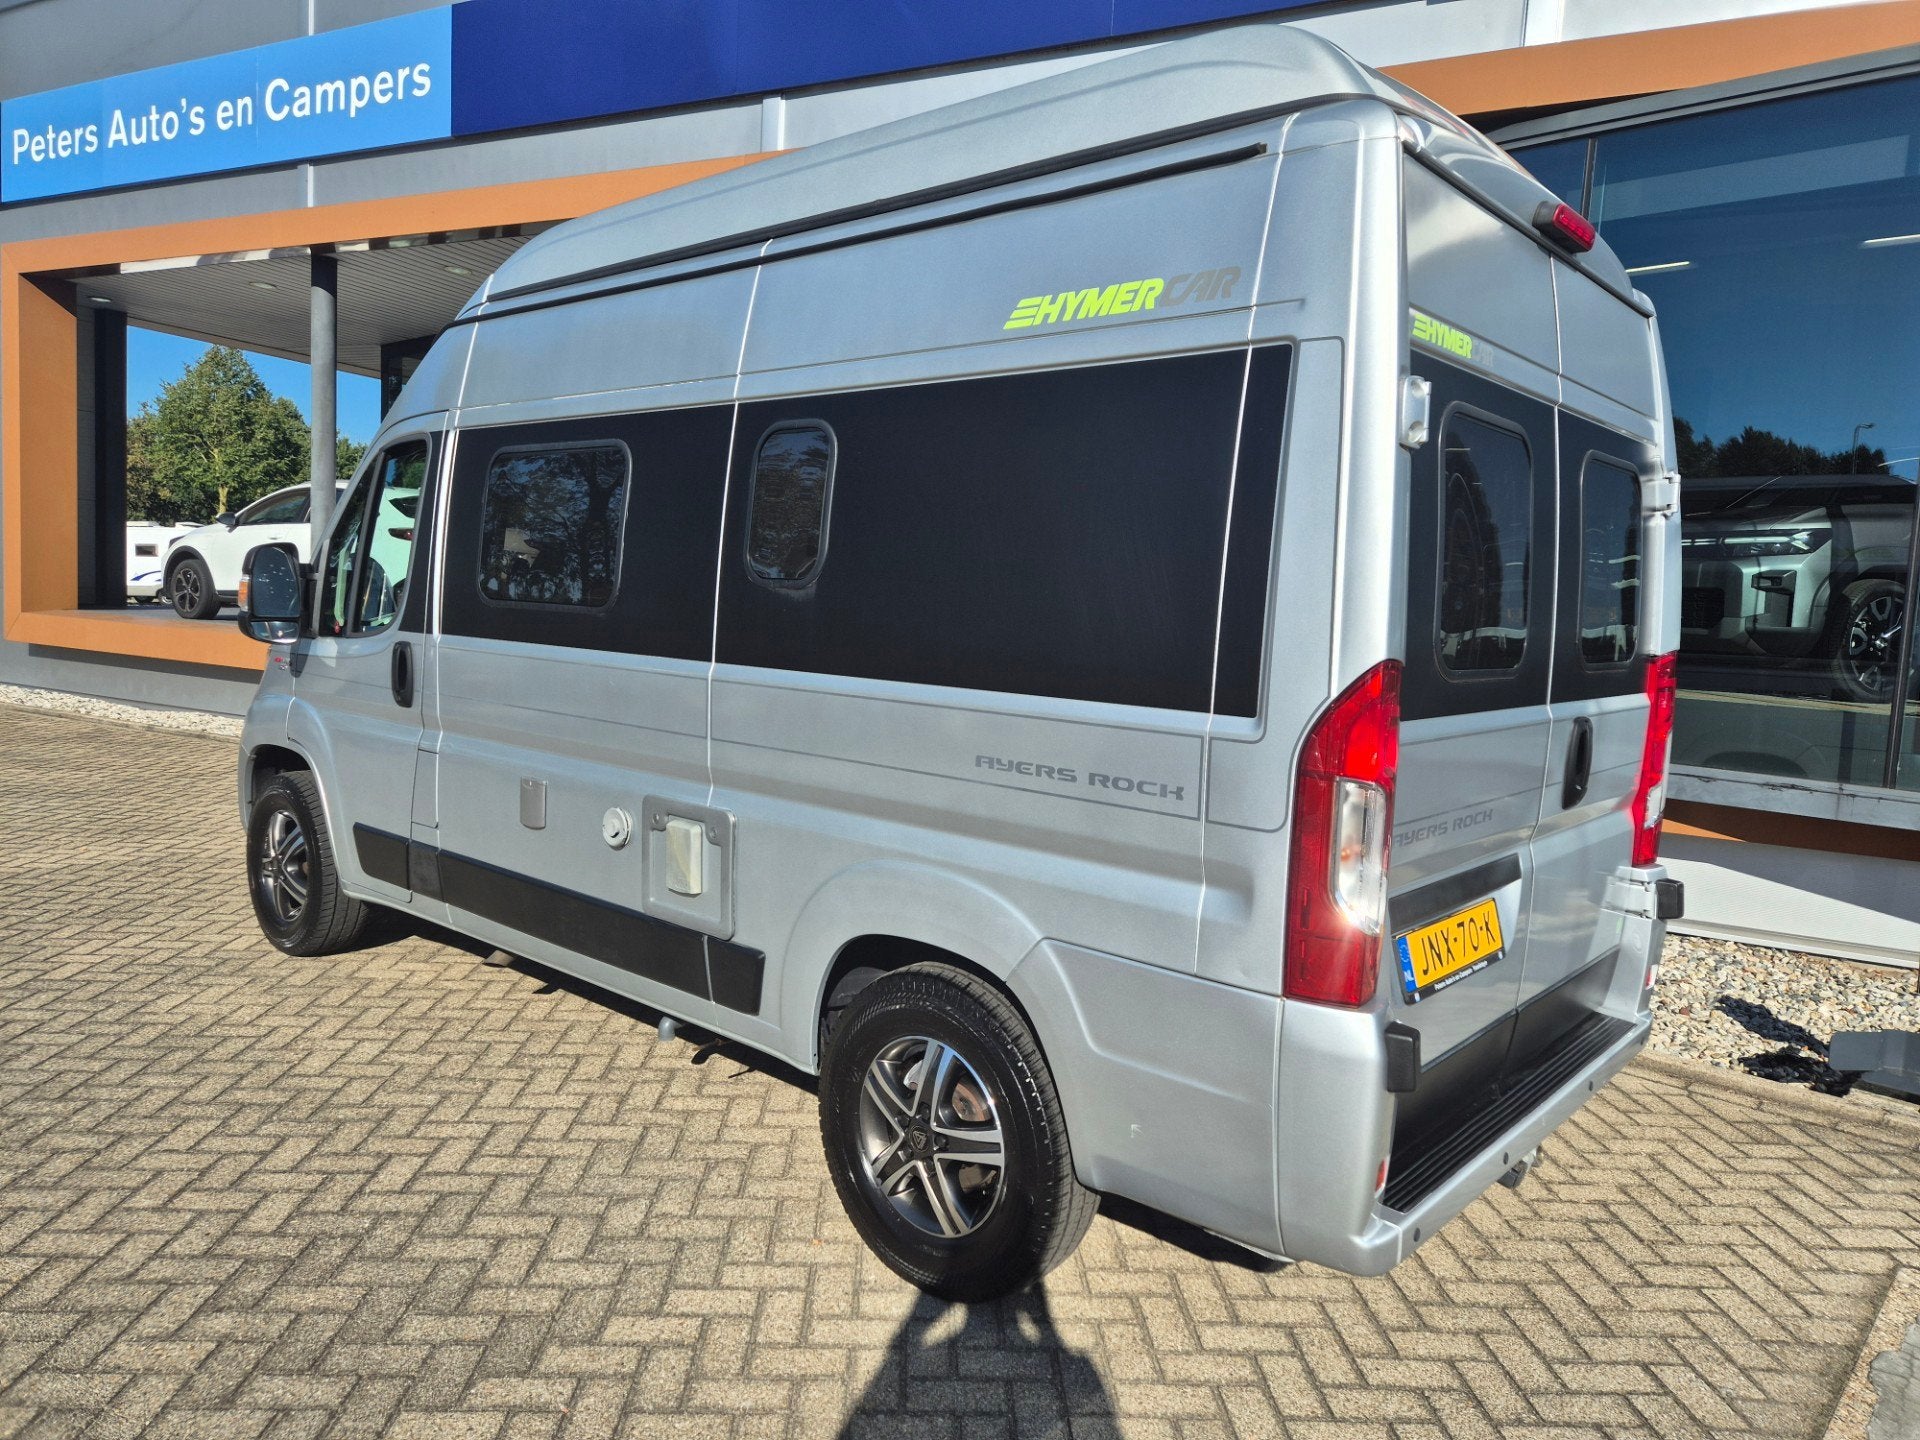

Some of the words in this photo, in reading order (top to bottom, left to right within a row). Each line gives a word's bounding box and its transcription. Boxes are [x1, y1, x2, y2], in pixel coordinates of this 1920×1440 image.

[13, 122, 98, 165] Peters
[107, 98, 206, 149] Auto's
[216, 95, 254, 131] en
[264, 62, 432, 121] Campers
[975, 754, 1078, 783] AYERS
[1088, 772, 1185, 801] ROCK
[1421, 910, 1496, 976] JNX-70-K
